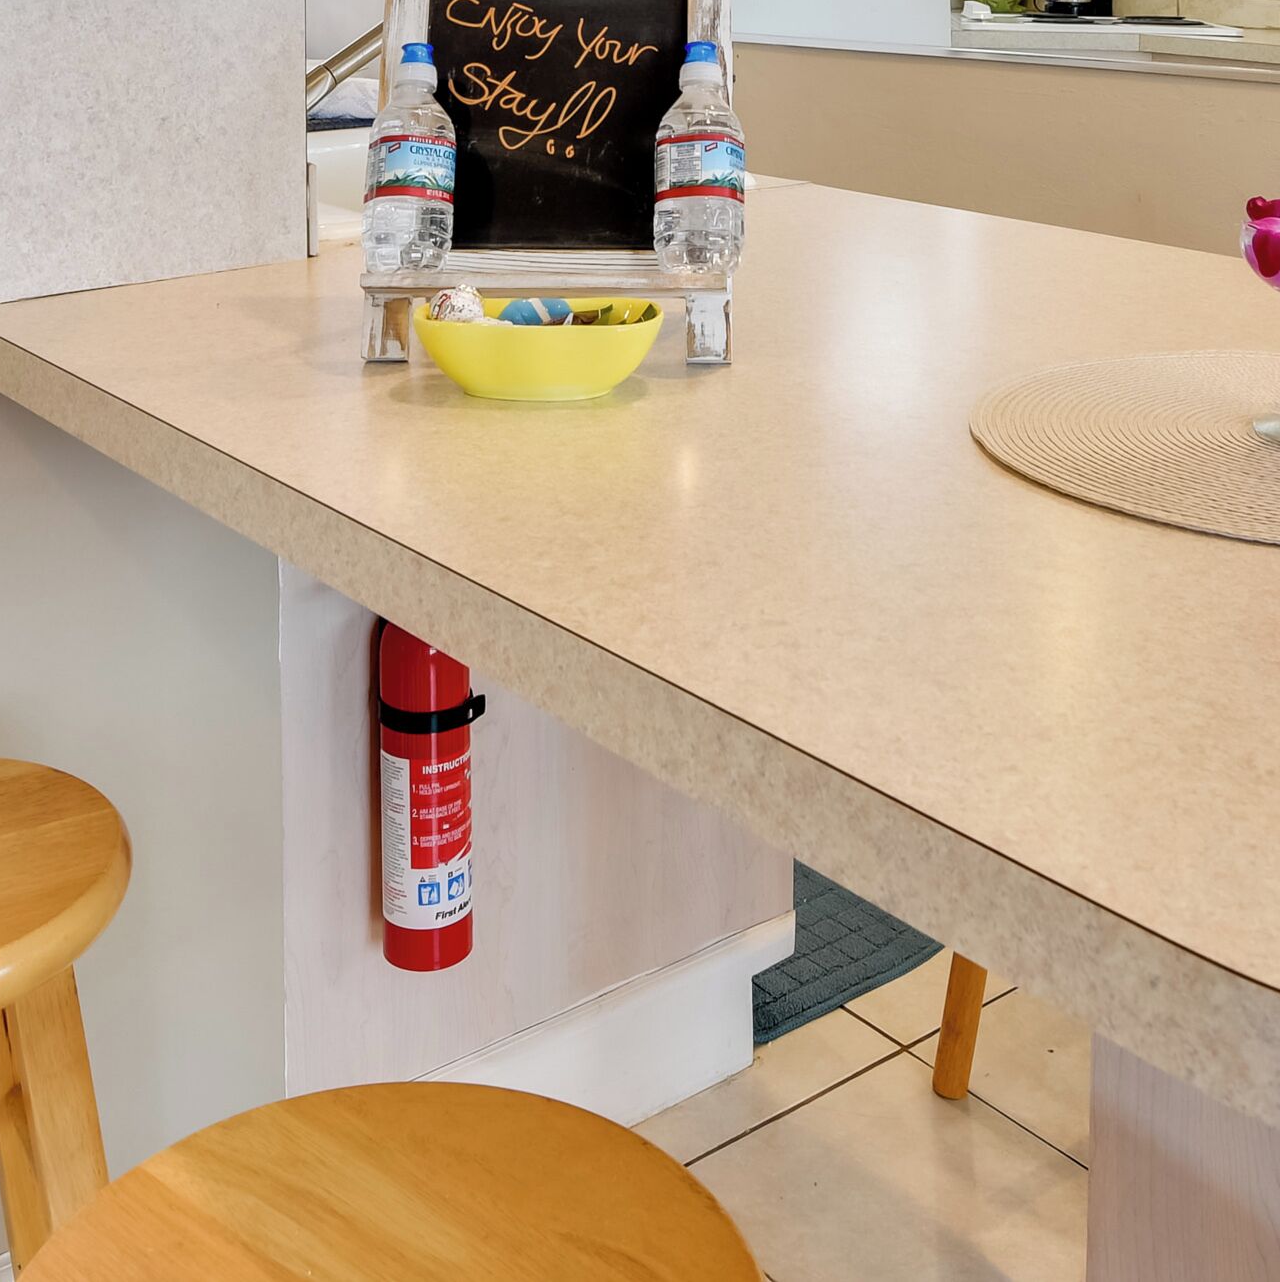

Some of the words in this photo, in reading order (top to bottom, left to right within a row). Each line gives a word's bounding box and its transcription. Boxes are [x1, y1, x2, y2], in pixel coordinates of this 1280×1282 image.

[575, 17, 659, 69] Your
[409, 144, 442, 158] CRYSTAL
[435, 906, 457, 921] First
